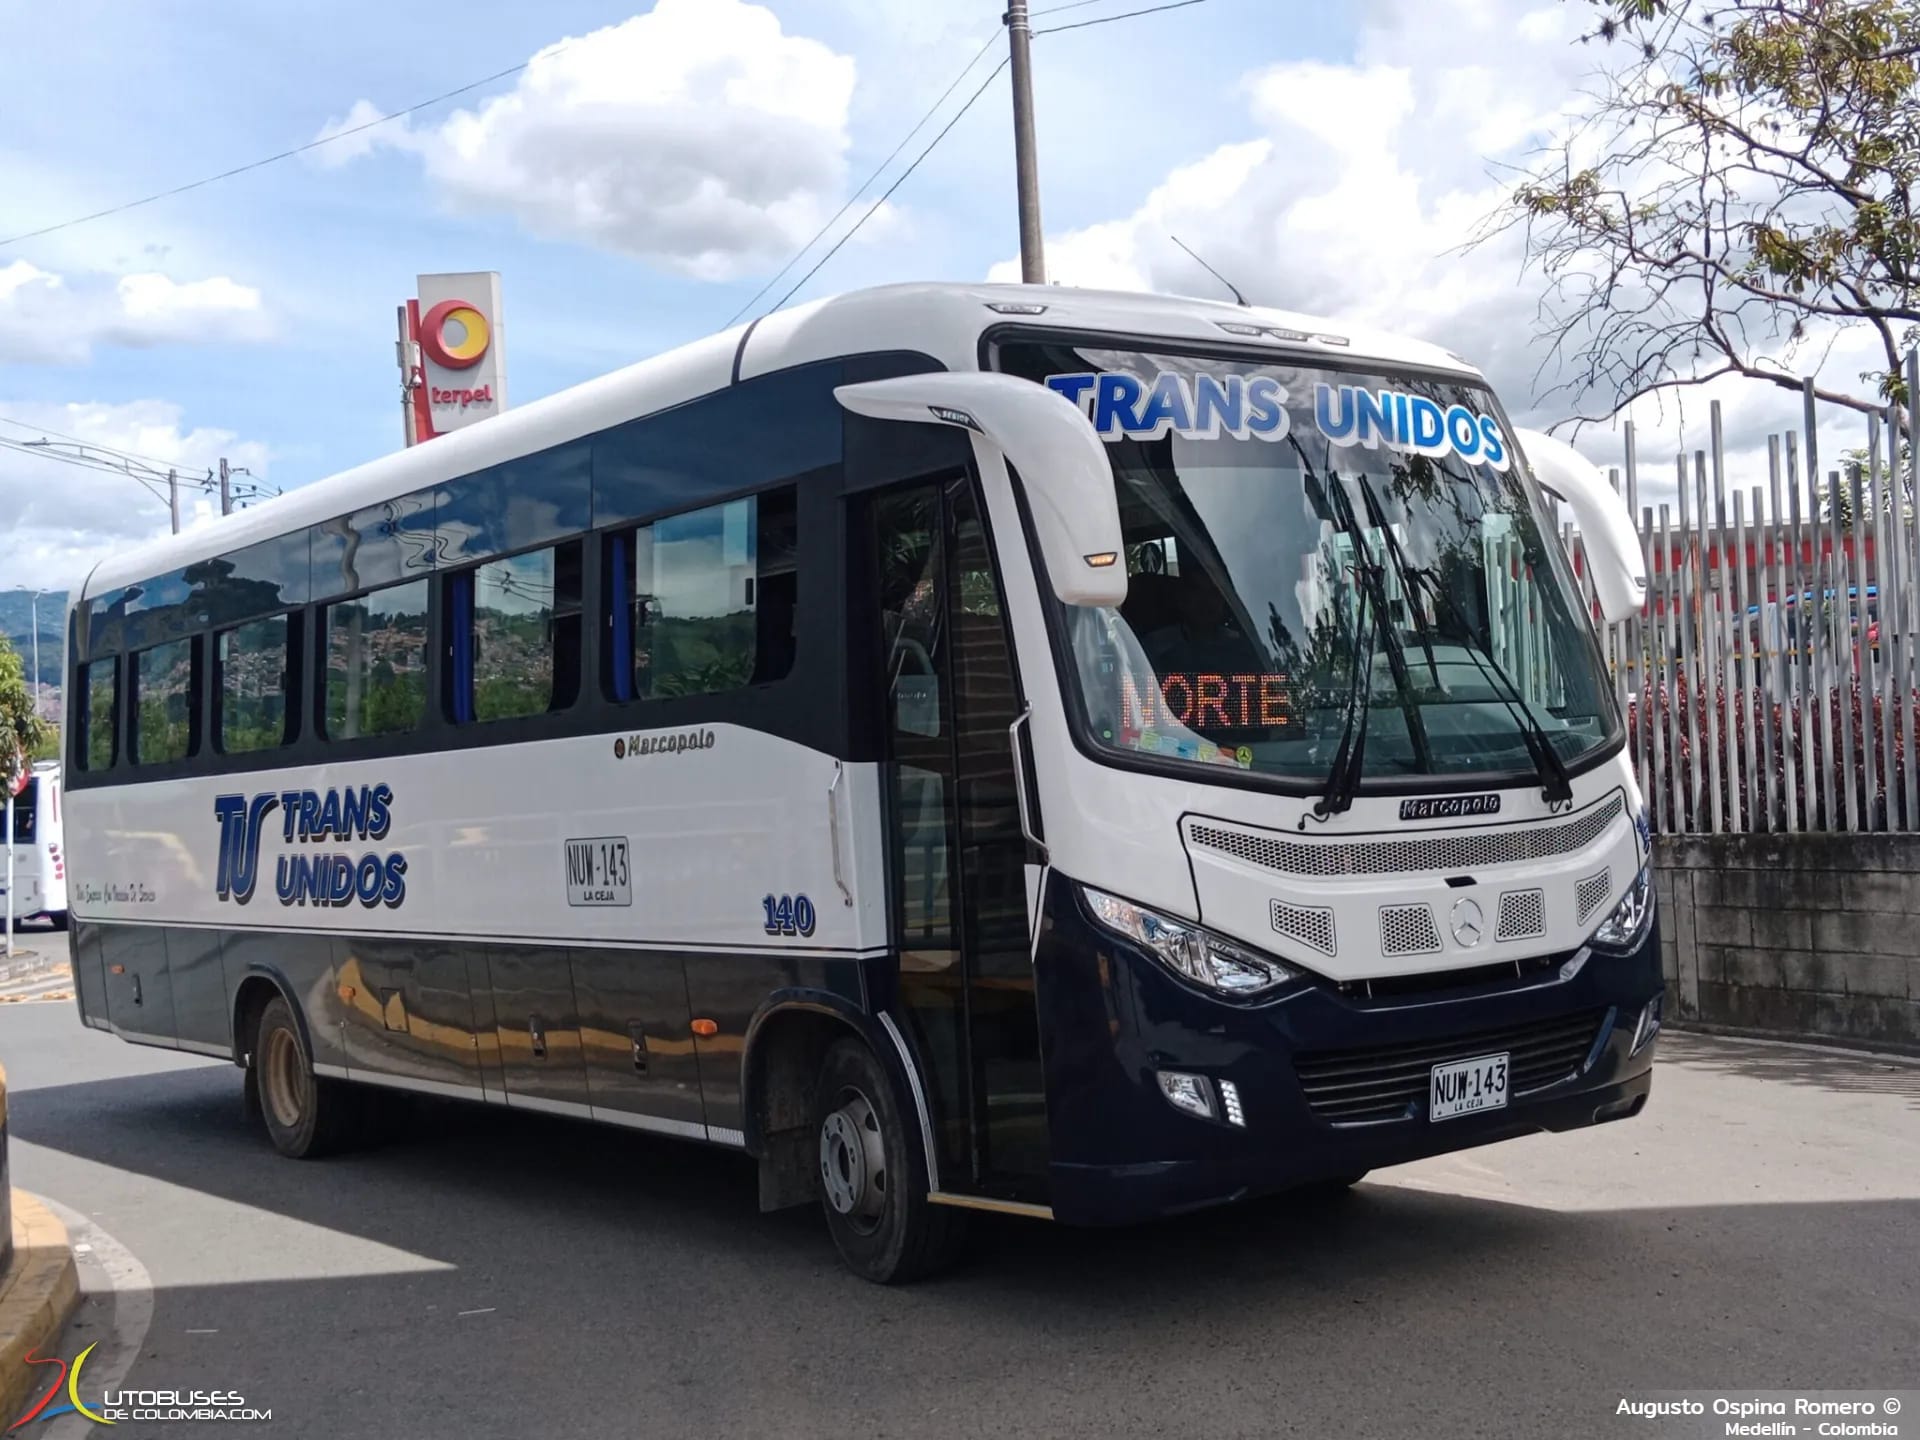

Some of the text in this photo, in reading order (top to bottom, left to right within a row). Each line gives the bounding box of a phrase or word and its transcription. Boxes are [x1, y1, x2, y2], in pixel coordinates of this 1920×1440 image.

[431, 385, 493, 407] terpel
[1045, 372, 1510, 472] TRANS UNIDOS
[1122, 674, 1287, 728] NORTE
[628, 728, 715, 757] Marcopolo
[281, 782, 394, 843] TRANS
[1402, 795, 1498, 818] Marcopolo
[276, 851, 409, 909] UNIDOS
[583, 891, 615, 901] LA CEJA
[763, 893, 817, 938] 140
